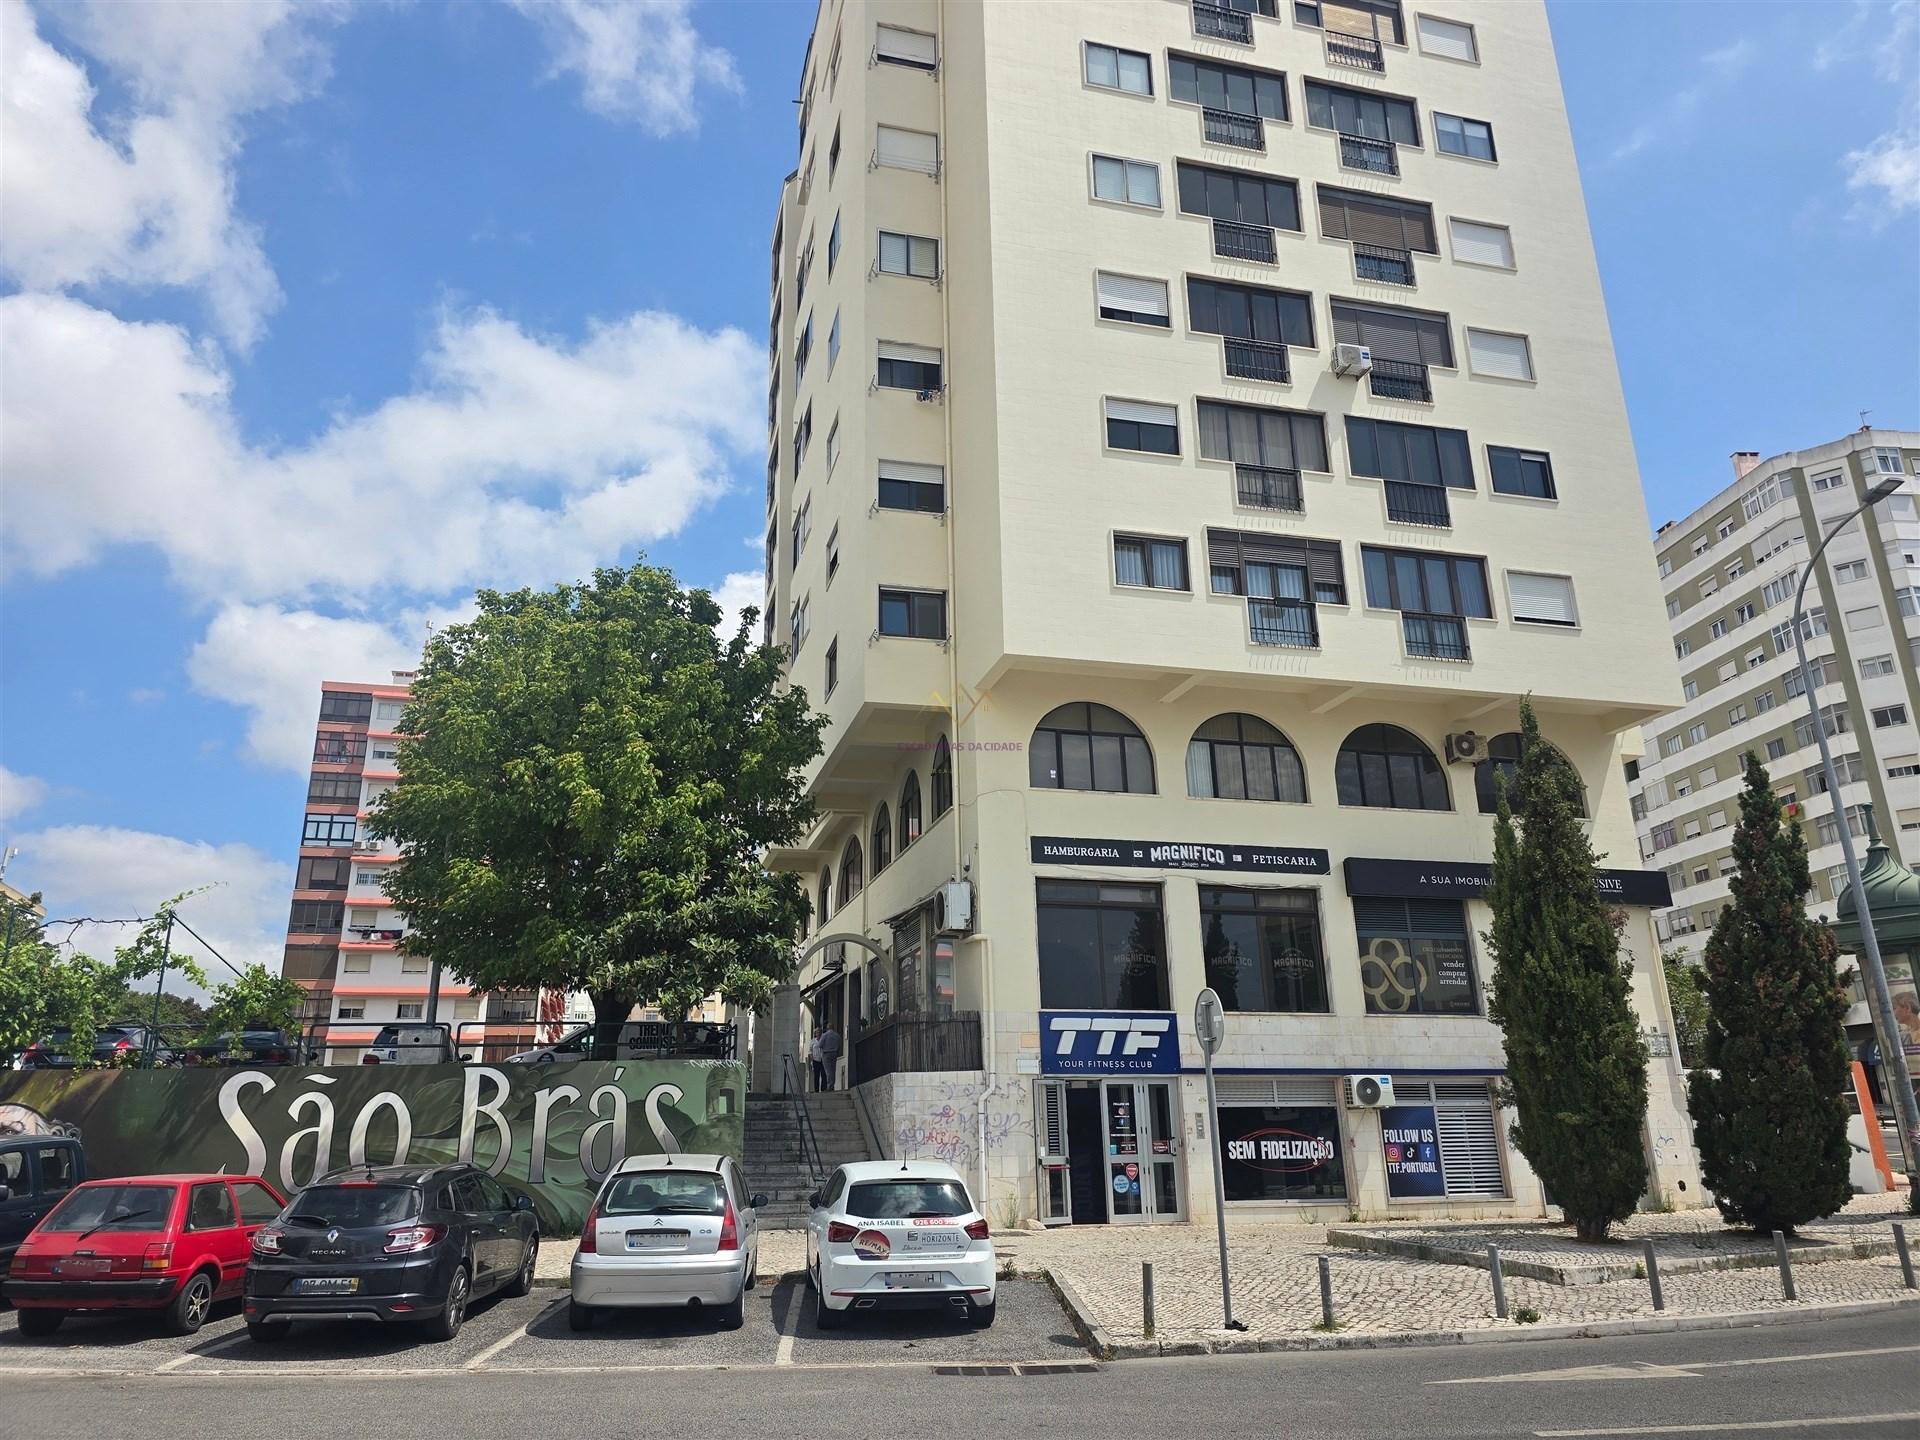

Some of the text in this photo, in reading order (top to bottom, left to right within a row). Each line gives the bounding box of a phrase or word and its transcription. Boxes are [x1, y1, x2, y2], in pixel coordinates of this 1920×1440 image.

[1043, 846, 1120, 858] HAMBURGARIA
[1150, 845, 1226, 865] MAGNIFICO
[1252, 854, 1318, 866] PETISCARIA
[1420, 875, 1427, 883] A
[1431, 876, 1451, 884] SUA
[1273, 959, 1314, 968] MAGNIFICO
[1439, 970, 1466, 978] comprar
[1050, 1017, 1170, 1054] TTF
[1058, 1060, 1084, 1068] YOUR
[1088, 1060, 1125, 1068] FITNESS
[217, 1066, 685, 1196] São Brás
[1384, 1129, 1434, 1143] FOLLOW US
[1228, 1137, 1334, 1165] SEM FIDELIZAÇÃO
[1387, 1162, 1438, 1173] TTF.PORTUGAL
[921, 1234, 960, 1243] HORIZONTE
[859, 1239, 886, 1253] RE/MAX
